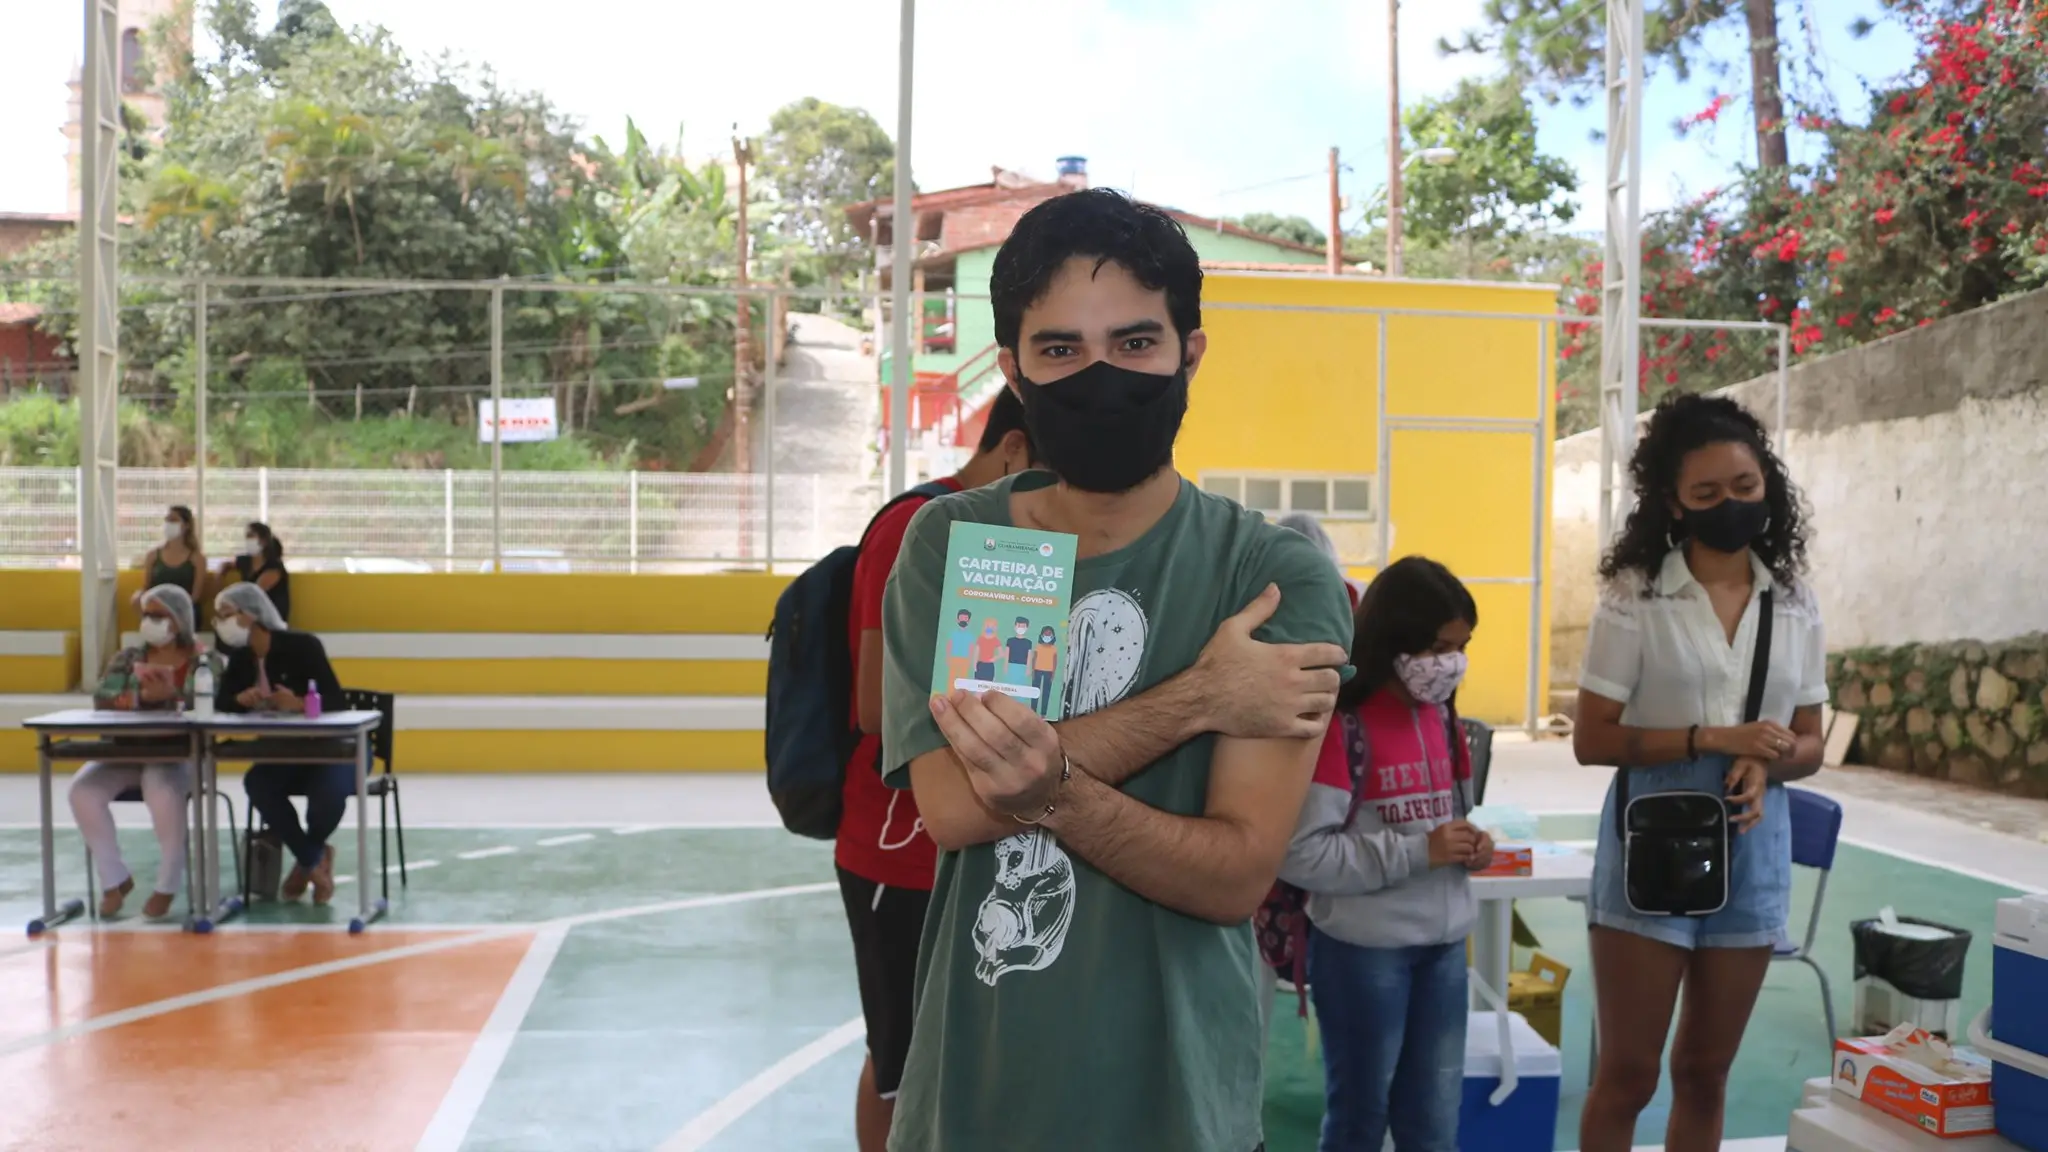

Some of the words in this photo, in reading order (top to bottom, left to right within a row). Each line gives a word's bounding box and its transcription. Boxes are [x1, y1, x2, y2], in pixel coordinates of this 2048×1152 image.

[959, 556, 1038, 576] CARTEIRA
[1042, 565, 1064, 579] DE
[962, 571, 1058, 592] VACINAÇÃO
[963, 589, 1015, 601] CORONAVÍRUS
[1021, 596, 1053, 605] COVID-19
[1378, 761, 1431, 792] HEY
